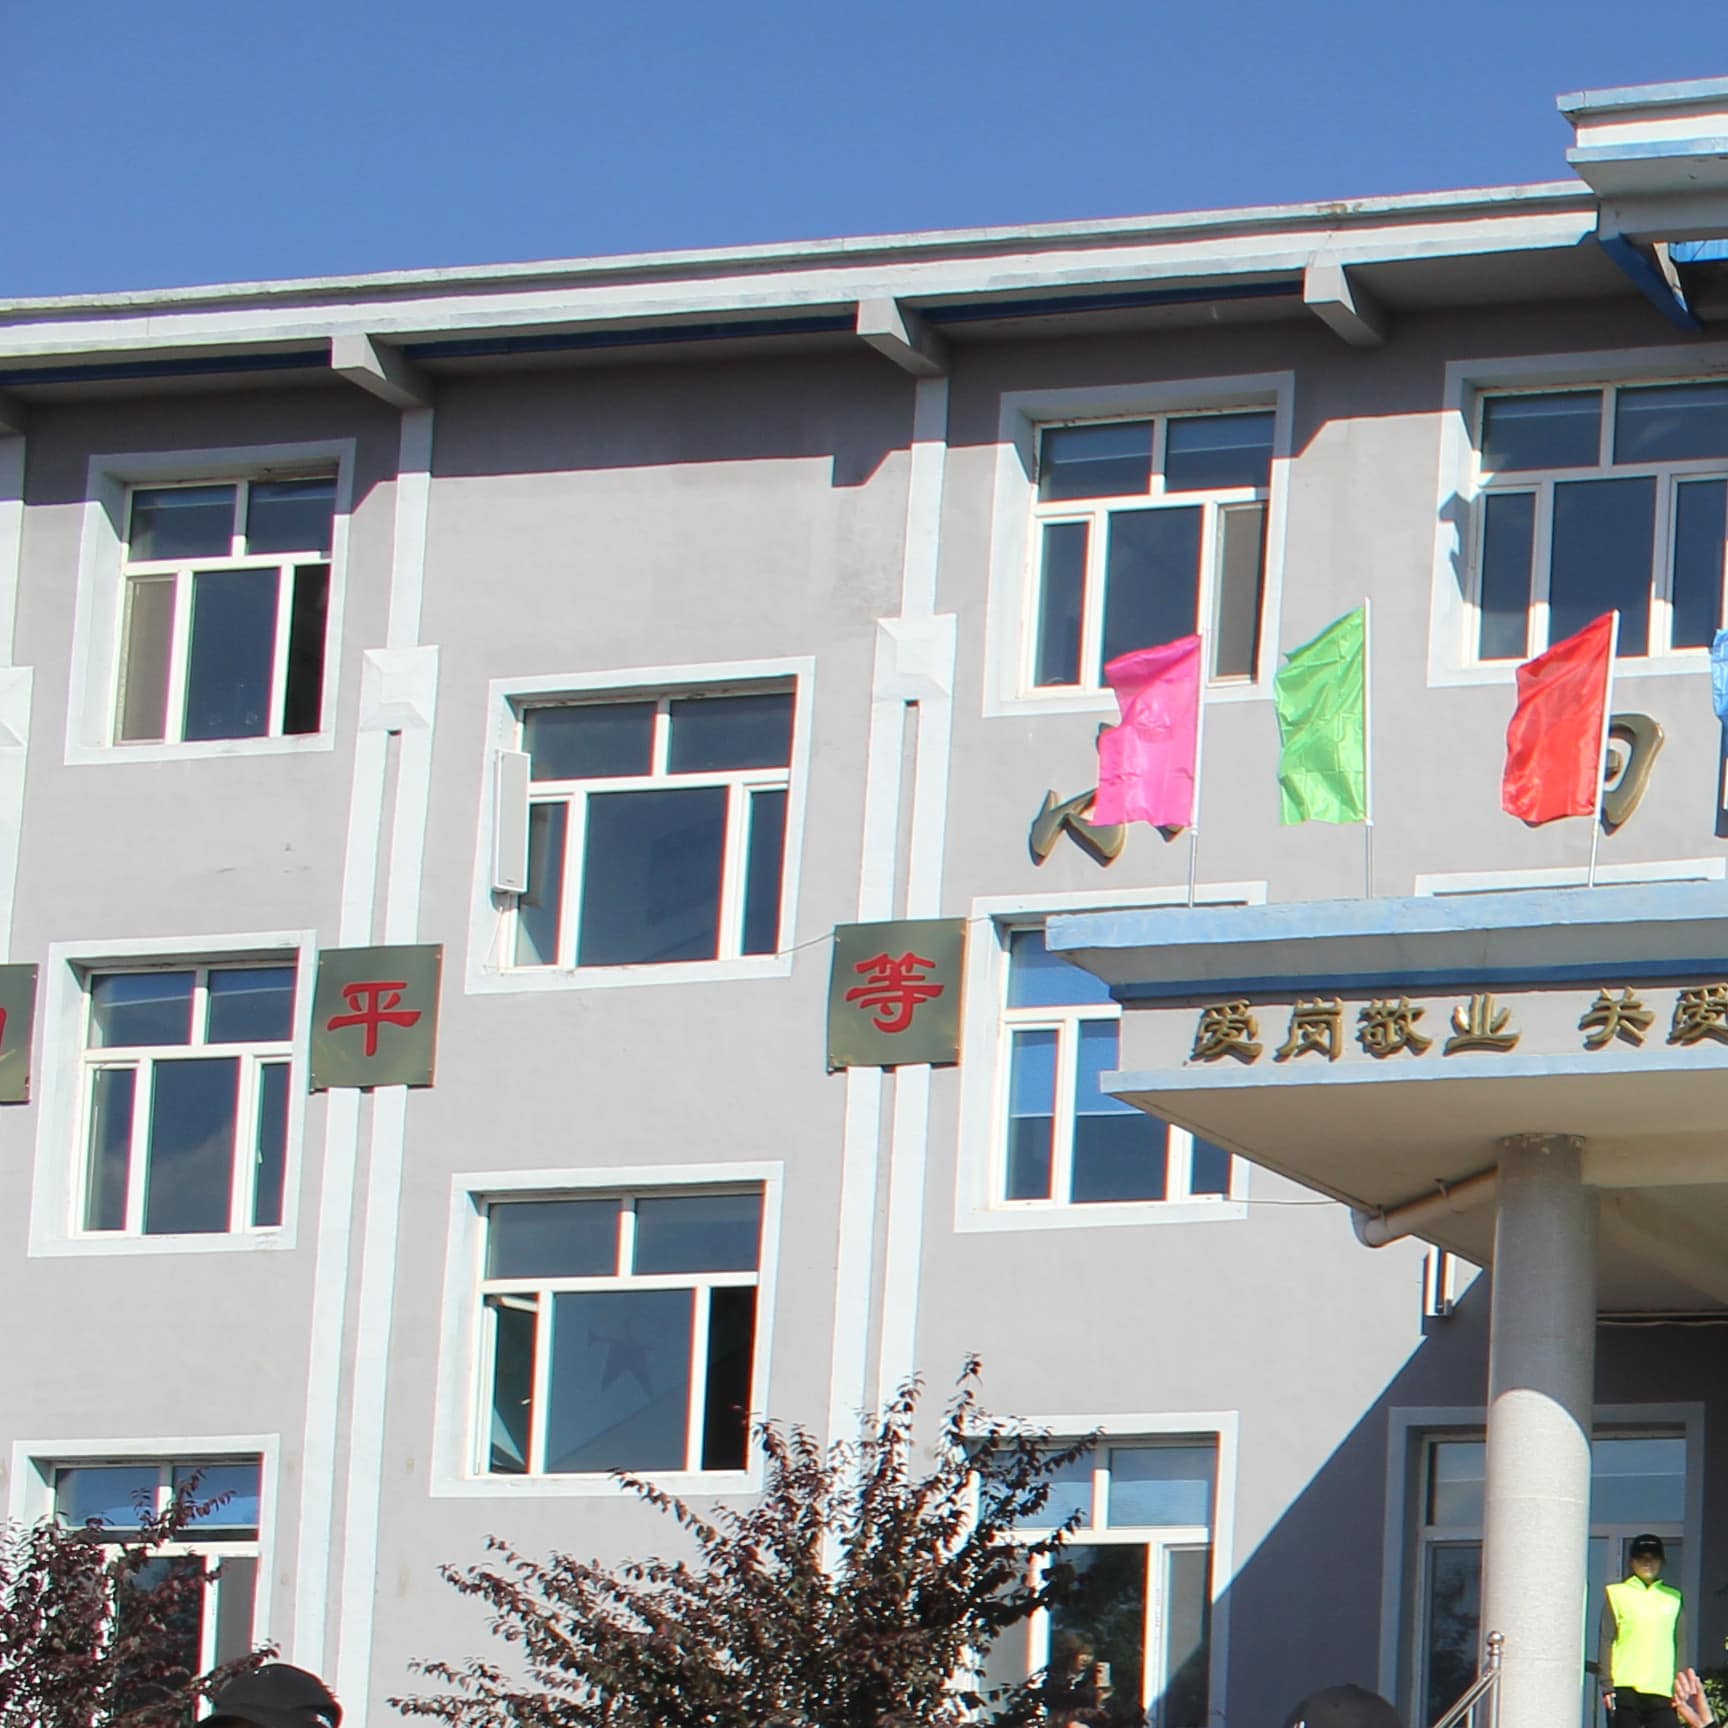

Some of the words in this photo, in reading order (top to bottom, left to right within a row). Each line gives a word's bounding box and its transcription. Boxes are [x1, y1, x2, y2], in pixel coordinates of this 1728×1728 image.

[326, 979, 422, 1058] 平
[845, 950, 944, 1034] 等
[1191, 993, 1522, 1065] 爱岗敬业
